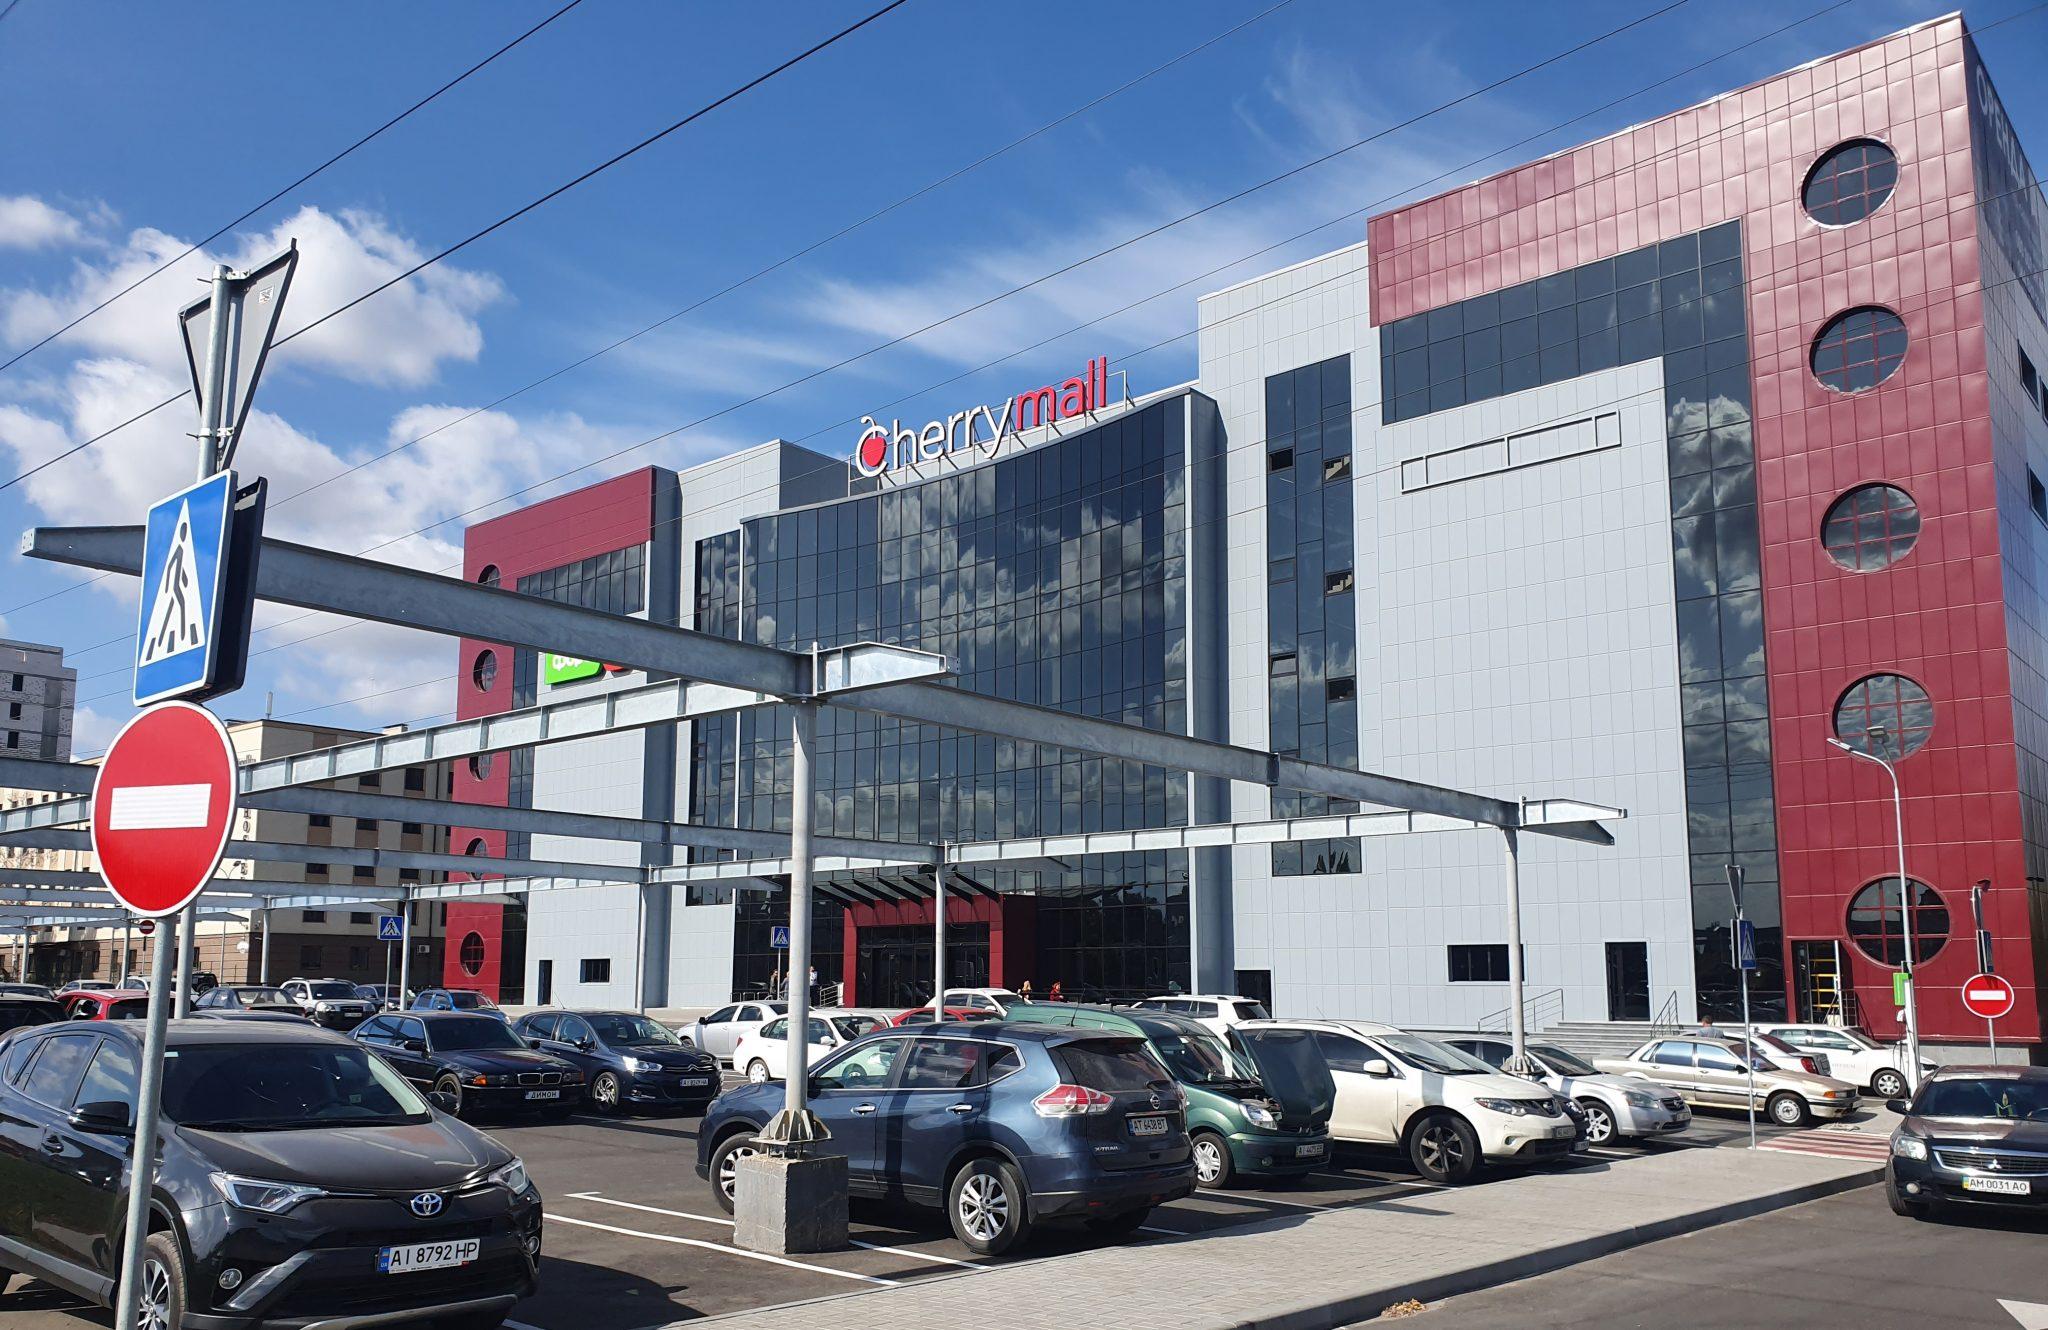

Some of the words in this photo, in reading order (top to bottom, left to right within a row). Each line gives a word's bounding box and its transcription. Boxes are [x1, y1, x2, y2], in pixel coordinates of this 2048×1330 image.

[531, 1091, 557, 1099] ДИМОН
[1134, 1120, 1143, 1131] AT
[1157, 1118, 1166, 1129] BT
[1970, 1179, 1984, 1188] AM
[1986, 1180, 2010, 1190] 0031
[2012, 1182, 2027, 1192] AO
[390, 1248, 411, 1267] AI
[416, 1244, 453, 1263] 8792
[455, 1242, 478, 1259] HP
